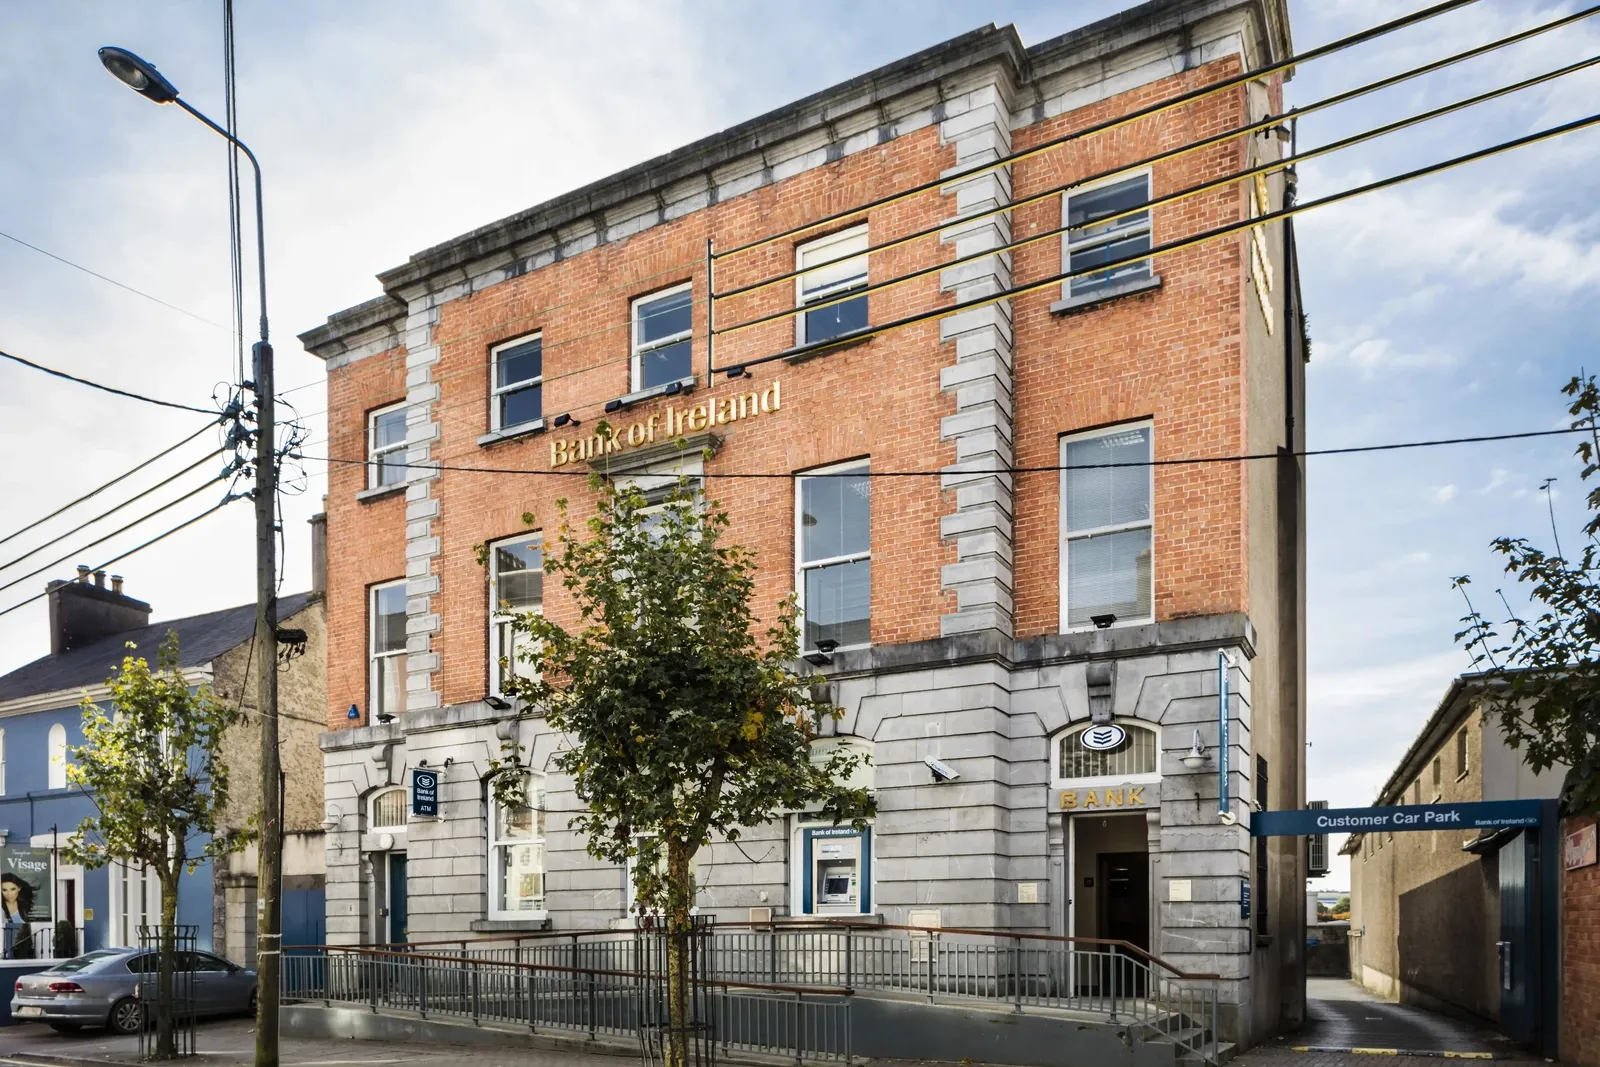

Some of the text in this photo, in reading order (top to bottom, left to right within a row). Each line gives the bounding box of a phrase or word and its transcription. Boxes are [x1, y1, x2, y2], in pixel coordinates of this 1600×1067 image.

[550, 381, 781, 468] Bank of Ireland
[1060, 786, 1145, 809] BANK
[1316, 810, 1460, 828] Customer Car Park
[7, 857, 47, 872] Visage
